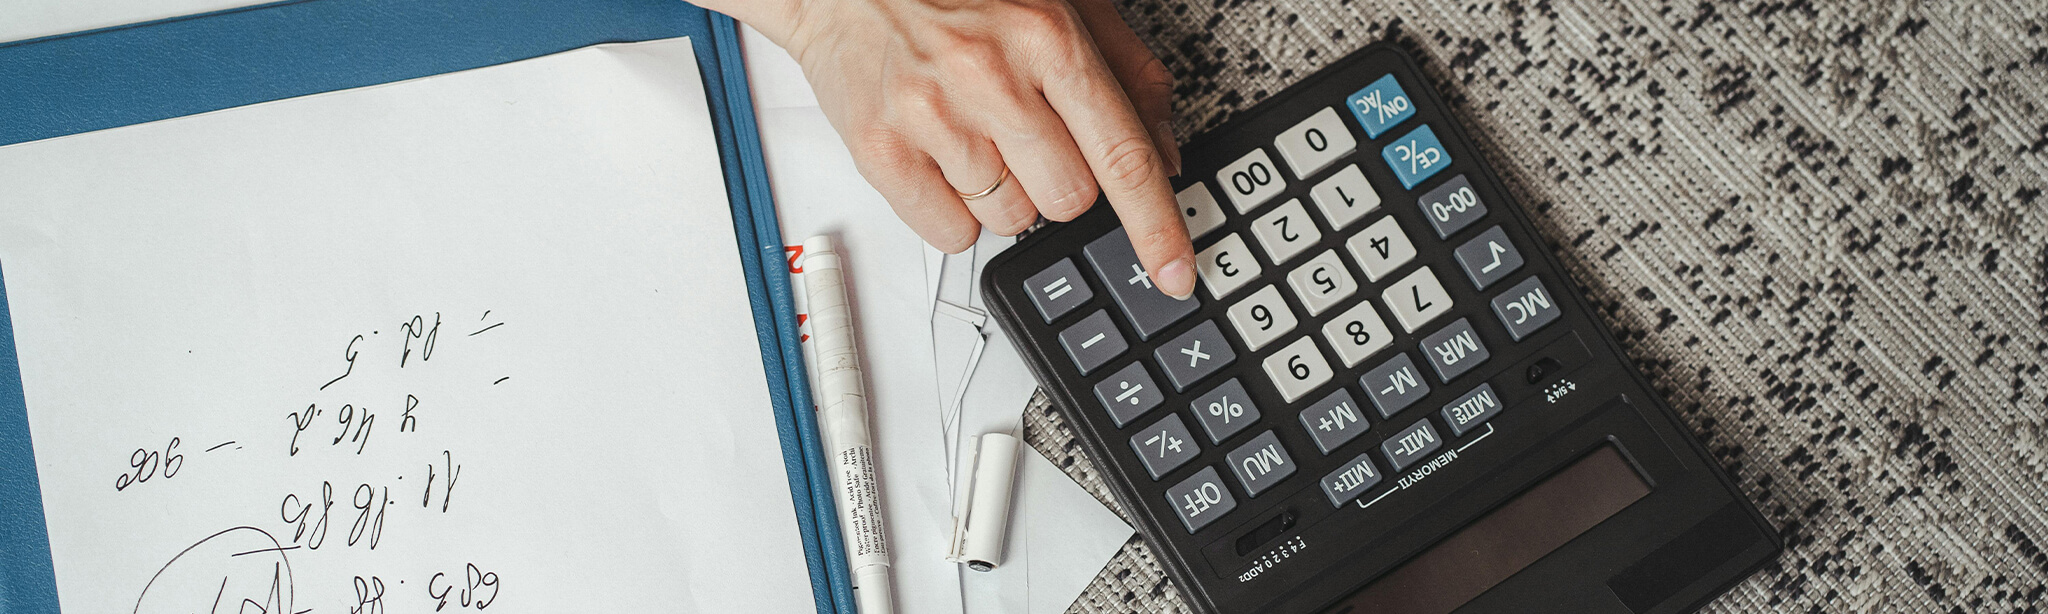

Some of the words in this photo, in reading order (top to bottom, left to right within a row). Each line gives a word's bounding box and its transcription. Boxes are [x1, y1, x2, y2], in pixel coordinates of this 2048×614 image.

[1356, 89, 1408, 124] ON/AC
[1305, 128, 1327, 151] 0
[1395, 140, 1440, 174] CE/C
[1232, 162, 1271, 195] 00
[1336, 187, 1354, 207] 1
[1273, 216, 1298, 242] 2
[1370, 237, 1388, 260] 4
[1215, 251, 1239, 277] 3
[1313, 267, 1336, 294] 5
[1412, 285, 1432, 312] 7
[1506, 288, 1550, 325] MC
[1251, 305, 1273, 331] 6
[1346, 321, 1370, 345] 8
[1435, 331, 1478, 365] MR
[1288, 355, 1309, 380] 9
[1209, 396, 1243, 424] %
[1242, 444, 1284, 481] MU
[1184, 481, 1221, 518] OFF
